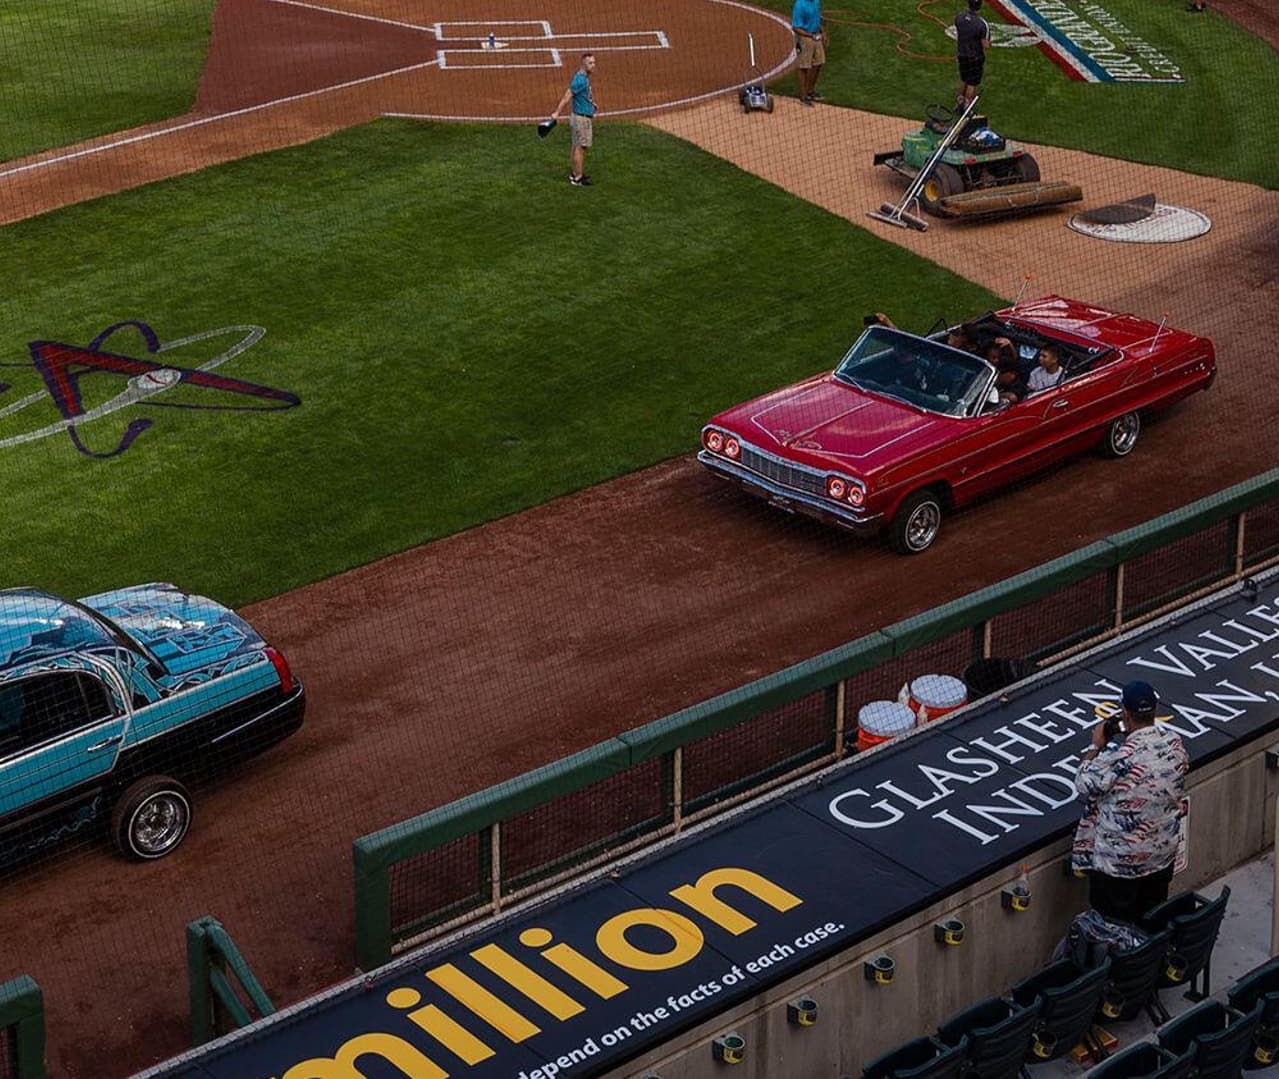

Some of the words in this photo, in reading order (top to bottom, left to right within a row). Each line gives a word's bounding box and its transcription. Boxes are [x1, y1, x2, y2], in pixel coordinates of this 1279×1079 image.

[828, 678, 1124, 829] GLASHEEN
[600, 1025, 633, 1047] on
[629, 1006, 671, 1032] the
[666, 981, 722, 1012] facts
[721, 964, 746, 986] of
[745, 943, 796, 974] each
[794, 921, 846, 949] case.
